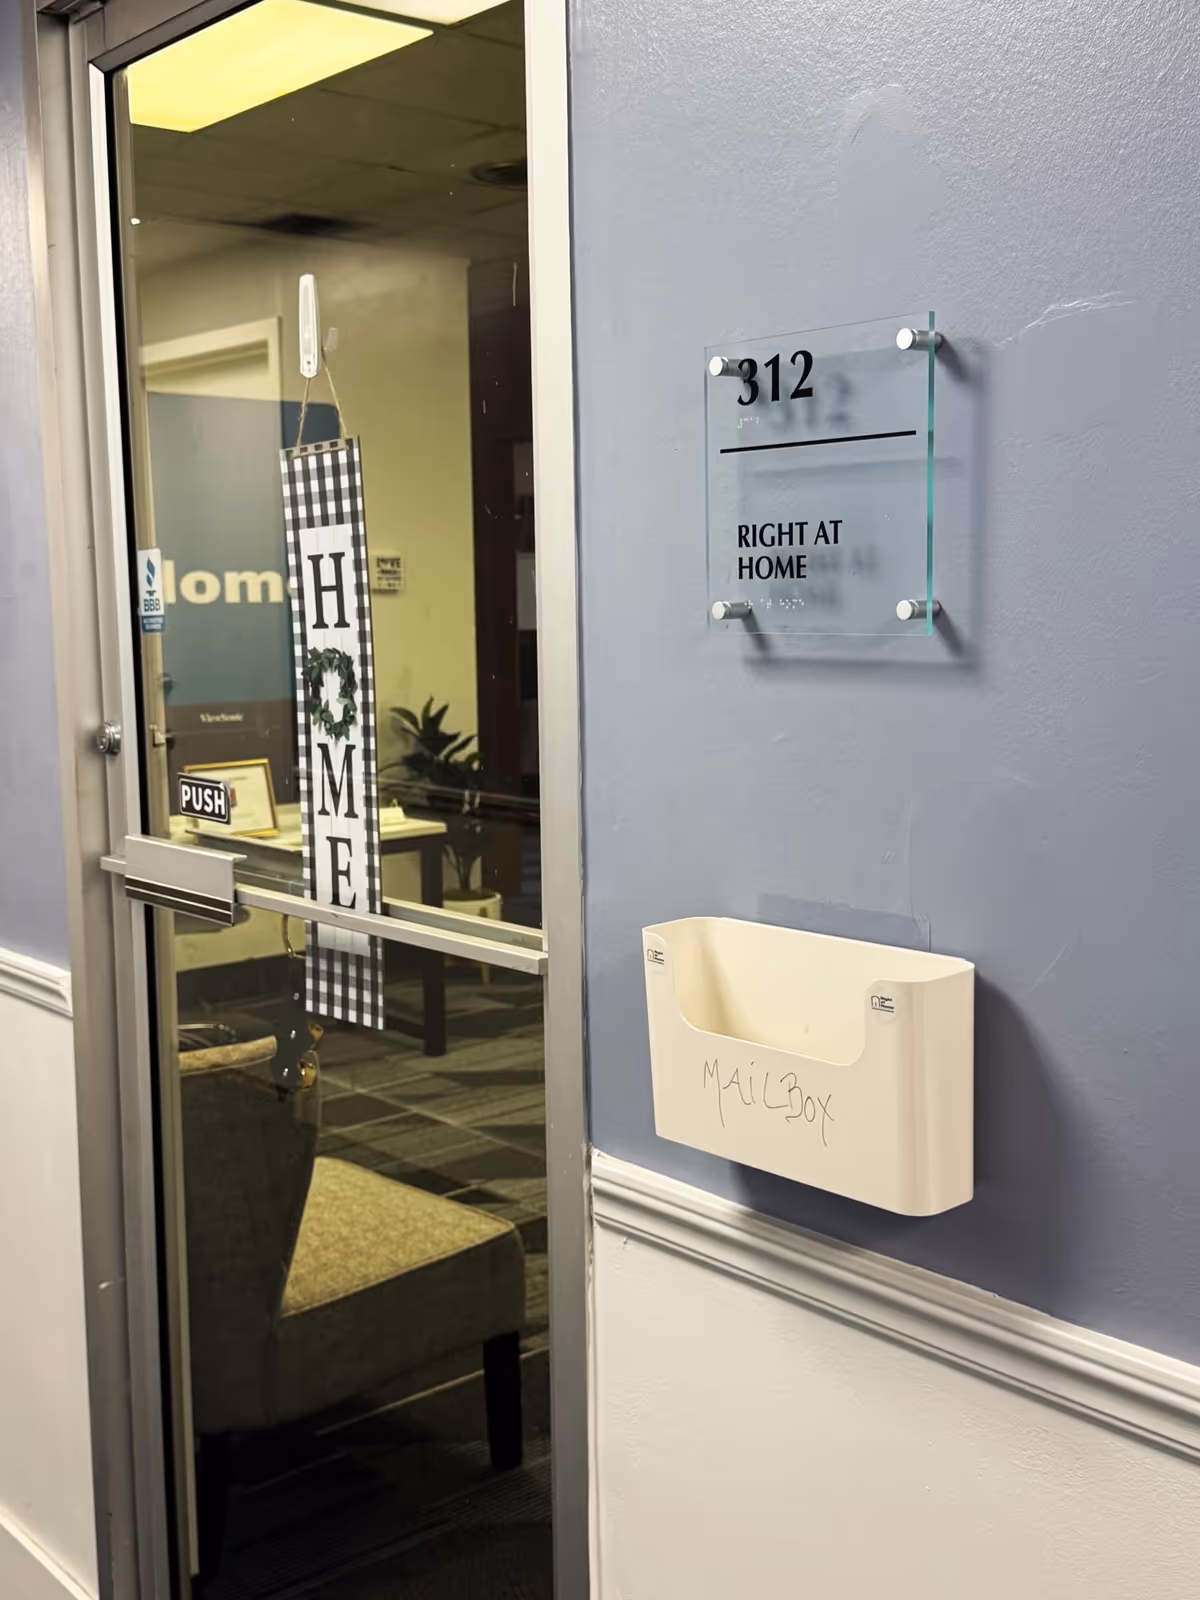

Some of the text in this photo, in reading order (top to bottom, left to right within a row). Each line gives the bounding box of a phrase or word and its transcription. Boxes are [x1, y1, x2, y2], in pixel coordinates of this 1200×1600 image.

[737, 350, 814, 406] 312
[737, 520, 843, 548] RIGHT AT
[162, 559, 292, 605] om
[737, 555, 807, 580] HOME
[144, 598, 161, 612] BBB
[181, 784, 226, 816] PUSH
